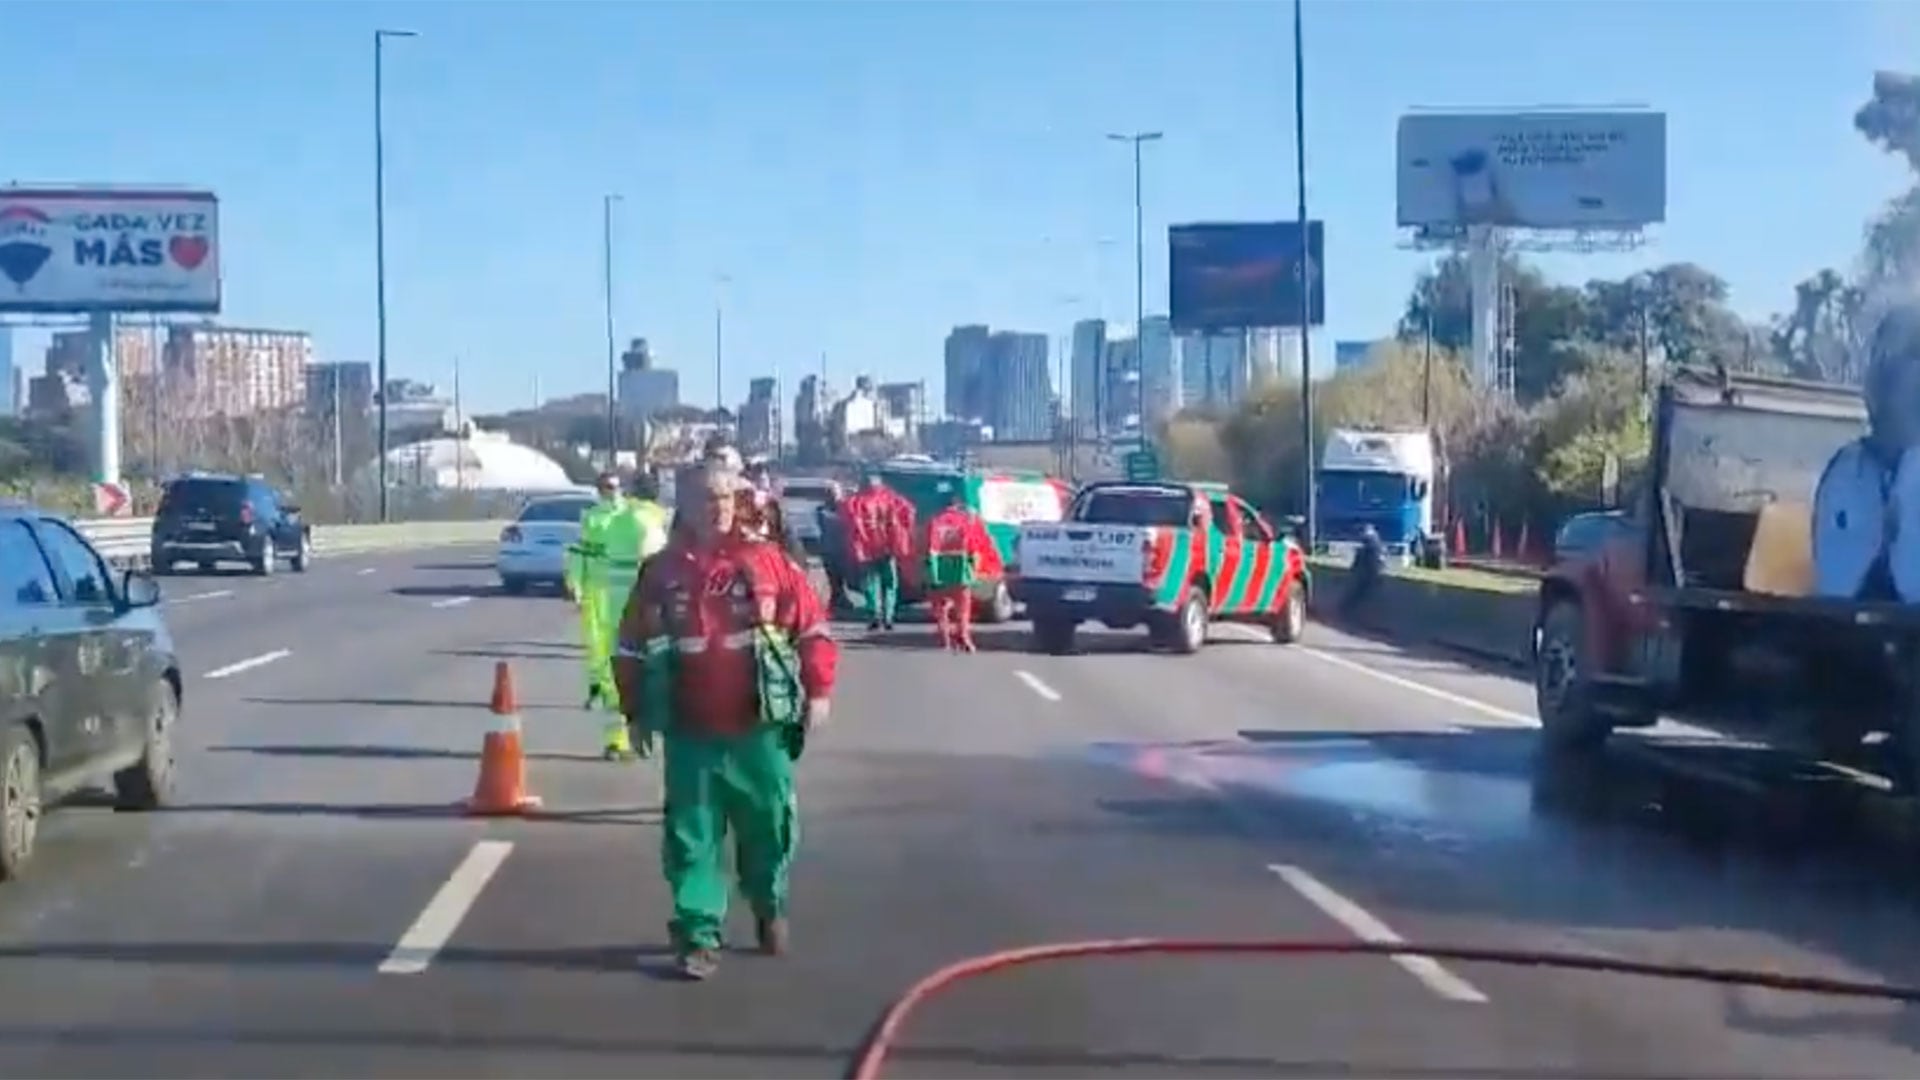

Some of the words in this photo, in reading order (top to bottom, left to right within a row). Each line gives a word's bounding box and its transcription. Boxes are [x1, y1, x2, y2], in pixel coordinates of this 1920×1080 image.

[74, 213, 148, 230] CADA
[158, 213, 206, 231] VEZ
[74, 232, 163, 266] MÁS
